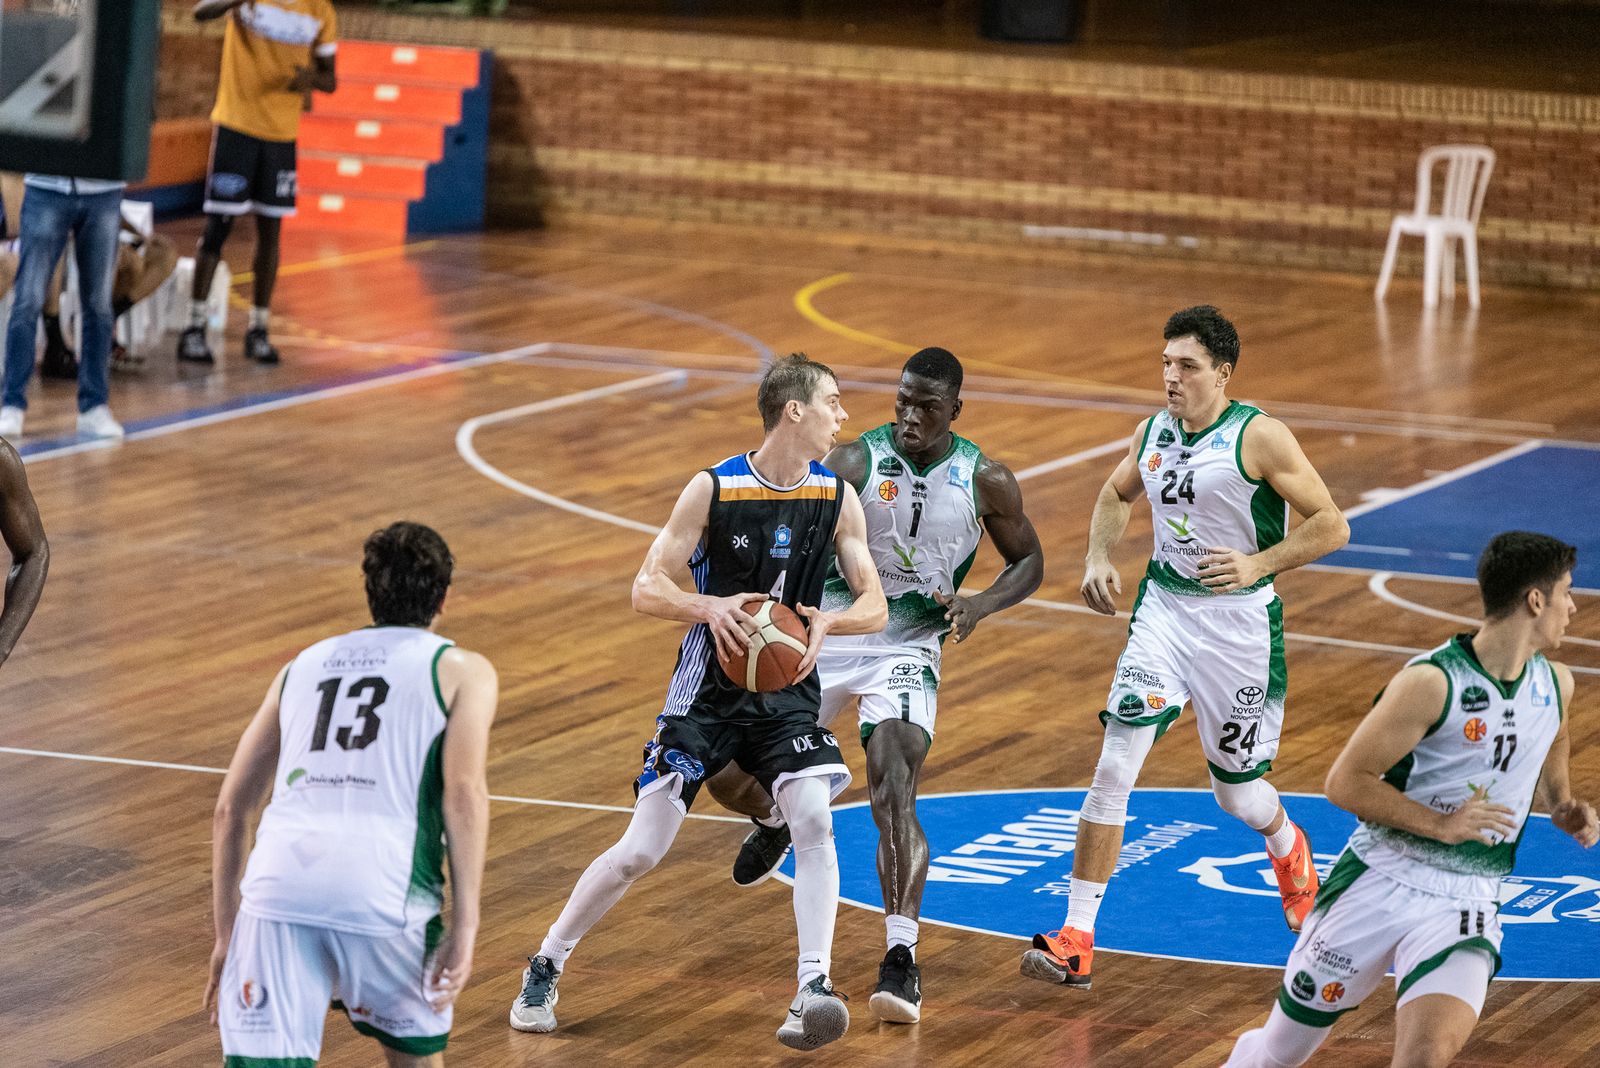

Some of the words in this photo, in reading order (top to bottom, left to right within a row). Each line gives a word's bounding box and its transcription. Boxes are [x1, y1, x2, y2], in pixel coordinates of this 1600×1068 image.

[1160, 469, 1196, 505] 24
[908, 501, 923, 538] 1
[769, 569, 787, 604] 4
[887, 676, 922, 687] TOYOTA
[308, 675, 391, 752] 13
[897, 691, 910, 722] 1
[1231, 705, 1262, 715] TOYOTA
[1217, 721, 1258, 755] 24
[1459, 909, 1486, 936] 11
